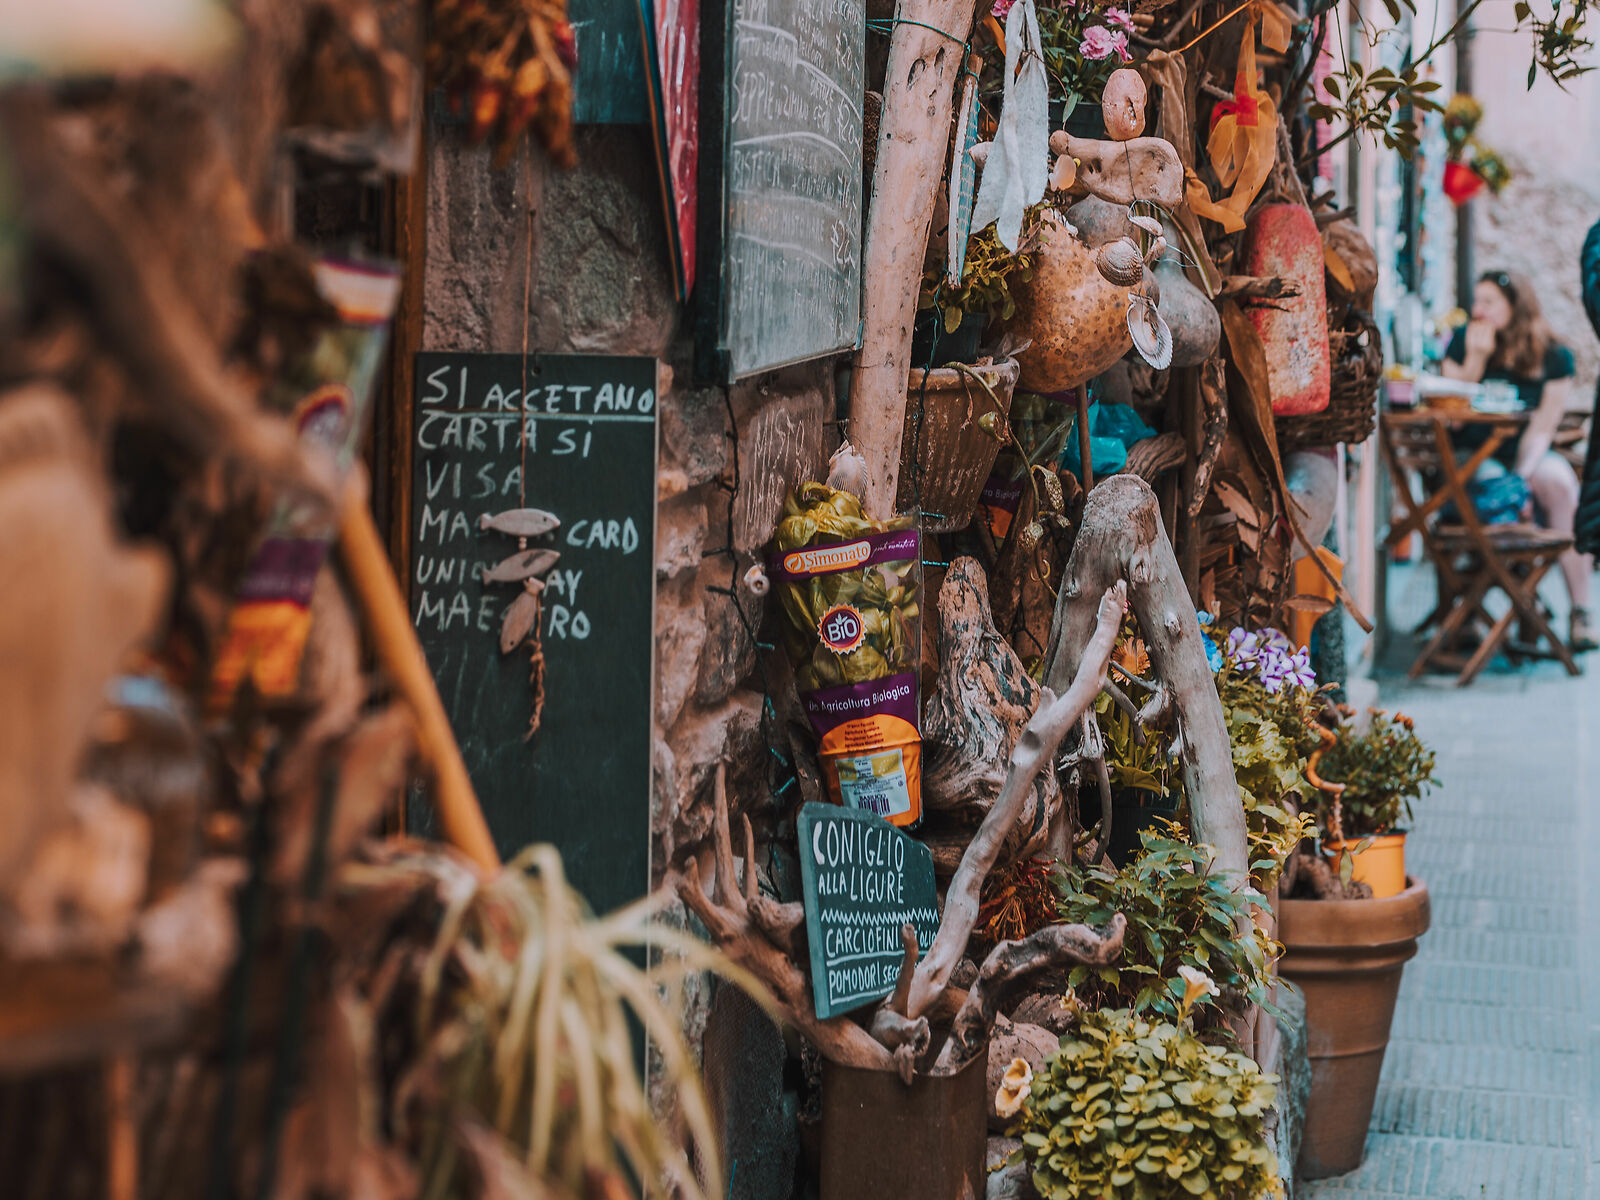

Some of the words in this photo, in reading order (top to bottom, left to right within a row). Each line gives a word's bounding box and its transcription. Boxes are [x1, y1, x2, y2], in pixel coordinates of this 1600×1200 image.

[731, 59, 774, 124] SEPPIE
[421, 366, 467, 409] SI
[481, 383, 655, 413] ACCETANO
[418, 411, 537, 453] CARTA
[426, 460, 525, 501] VISA
[567, 517, 639, 555] CARD
[805, 543, 868, 568] Simonato
[415, 590, 592, 640] MAERO
[821, 697, 871, 714] Agricoltura
[872, 684, 910, 704] Biologica
[813, 821, 904, 873] CONIGLIO
[818, 871, 847, 895] ALLA
[850, 867, 904, 905] LIGURE
[826, 926, 899, 958] CARCIOFINI
[828, 961, 881, 998] POMODORI
